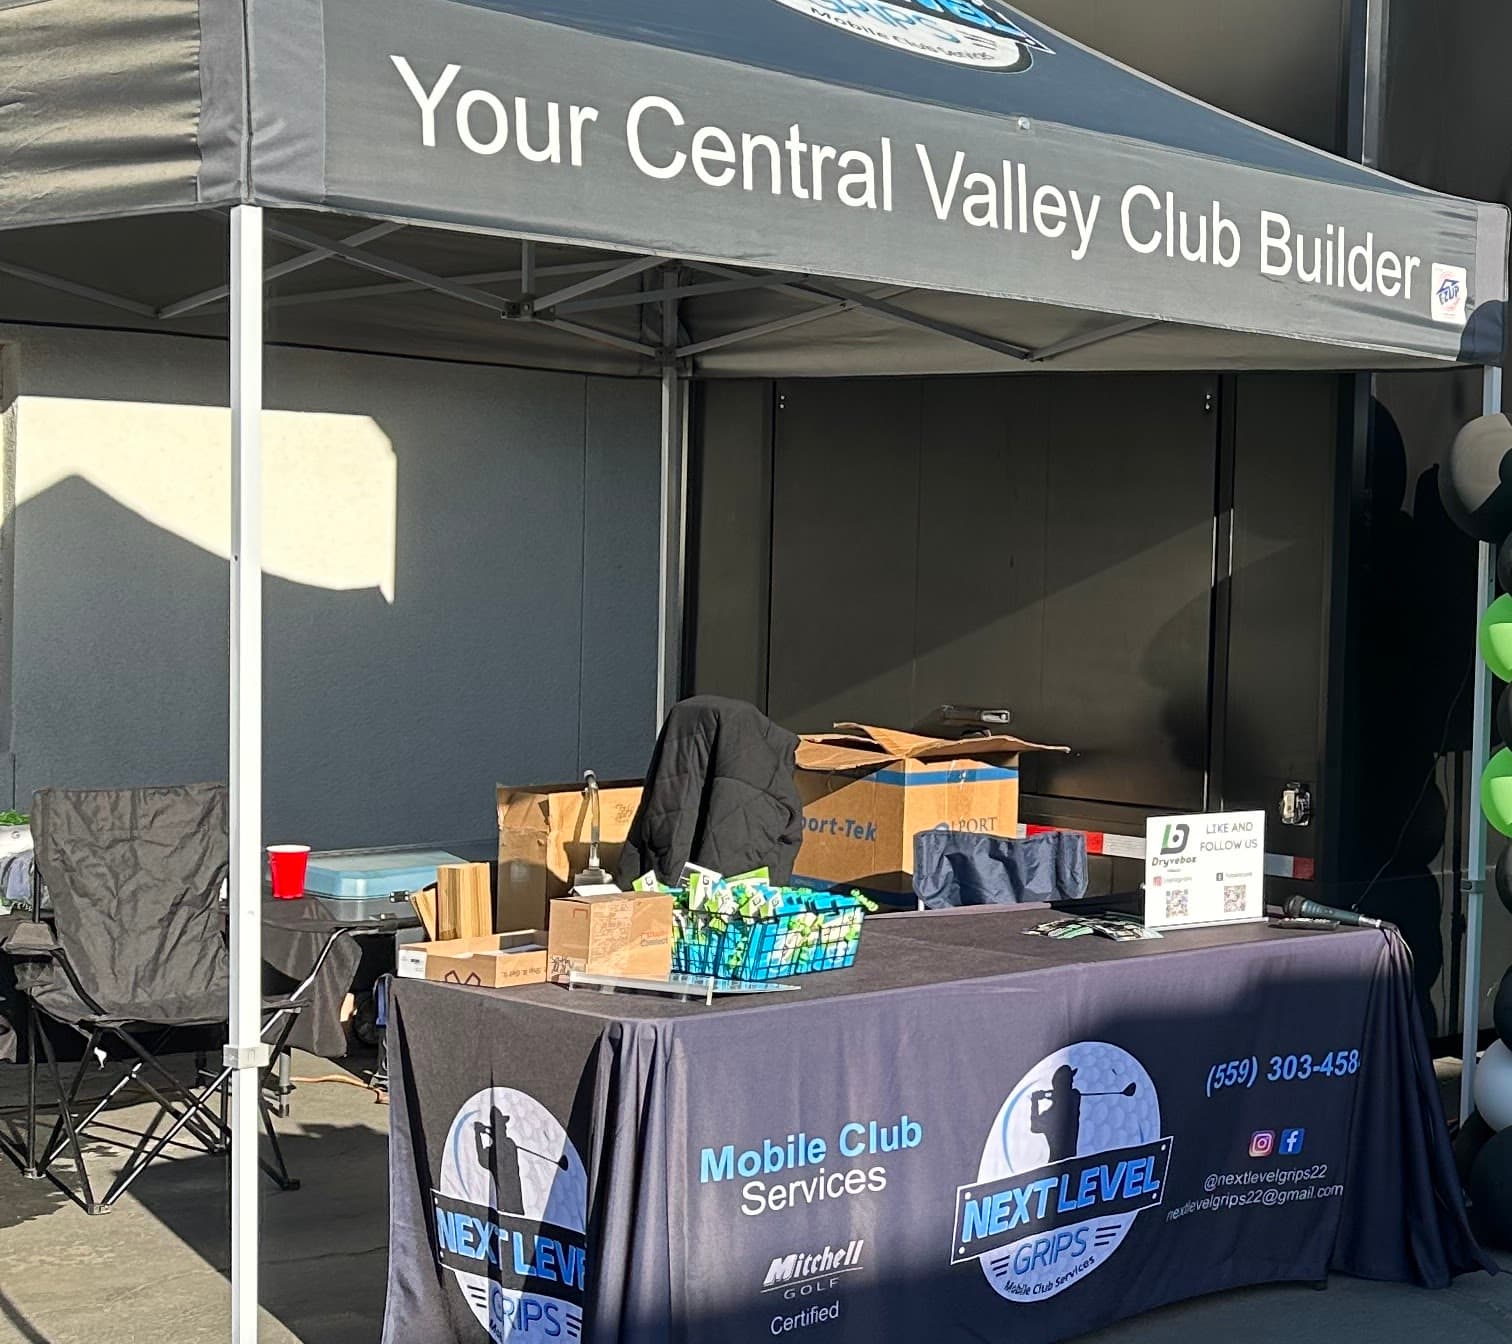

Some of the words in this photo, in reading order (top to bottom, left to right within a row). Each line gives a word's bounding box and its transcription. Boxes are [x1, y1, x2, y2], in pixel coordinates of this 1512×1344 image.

[810, 6, 890, 40] Mobile
[390, 54, 599, 167] Your
[626, 95, 893, 211] Central
[915, 143, 1101, 261] Valley
[1120, 183, 1241, 268] Club
[1259, 210, 1420, 300] Builder
[800, 815, 877, 842] port-Tek
[1200, 839, 1242, 852] FOLLOW
[1244, 838, 1258, 849] US
[1206, 823, 1229, 835] LIKE
[1231, 821, 1254, 833] AND
[1151, 855, 1197, 868] Dryvebox
[1206, 1056, 1258, 1097] (559)
[1267, 1049, 1361, 1082] 303-458
[700, 1132, 828, 1184] Mobile
[839, 1114, 924, 1157] Club
[740, 1166, 887, 1216] Services
[1203, 1164, 1328, 1192] @nextlevelgrips22
[961, 1176, 1059, 1244] NEXT
[1056, 1156, 1161, 1214] LEVEL
[1165, 1183, 1344, 1222] nextlevelgrips22@gmail.com
[763, 1239, 864, 1287] Mitchell
[1013, 1226, 1090, 1275] GRIPS
[783, 1277, 841, 1300] GOLF
[1003, 1278, 1031, 1296] Mobile
[1033, 1281, 1054, 1295] Club
[1054, 1256, 1096, 1288] Services
[491, 1287, 561, 1337] GRIPS
[770, 1300, 840, 1335] Certified
